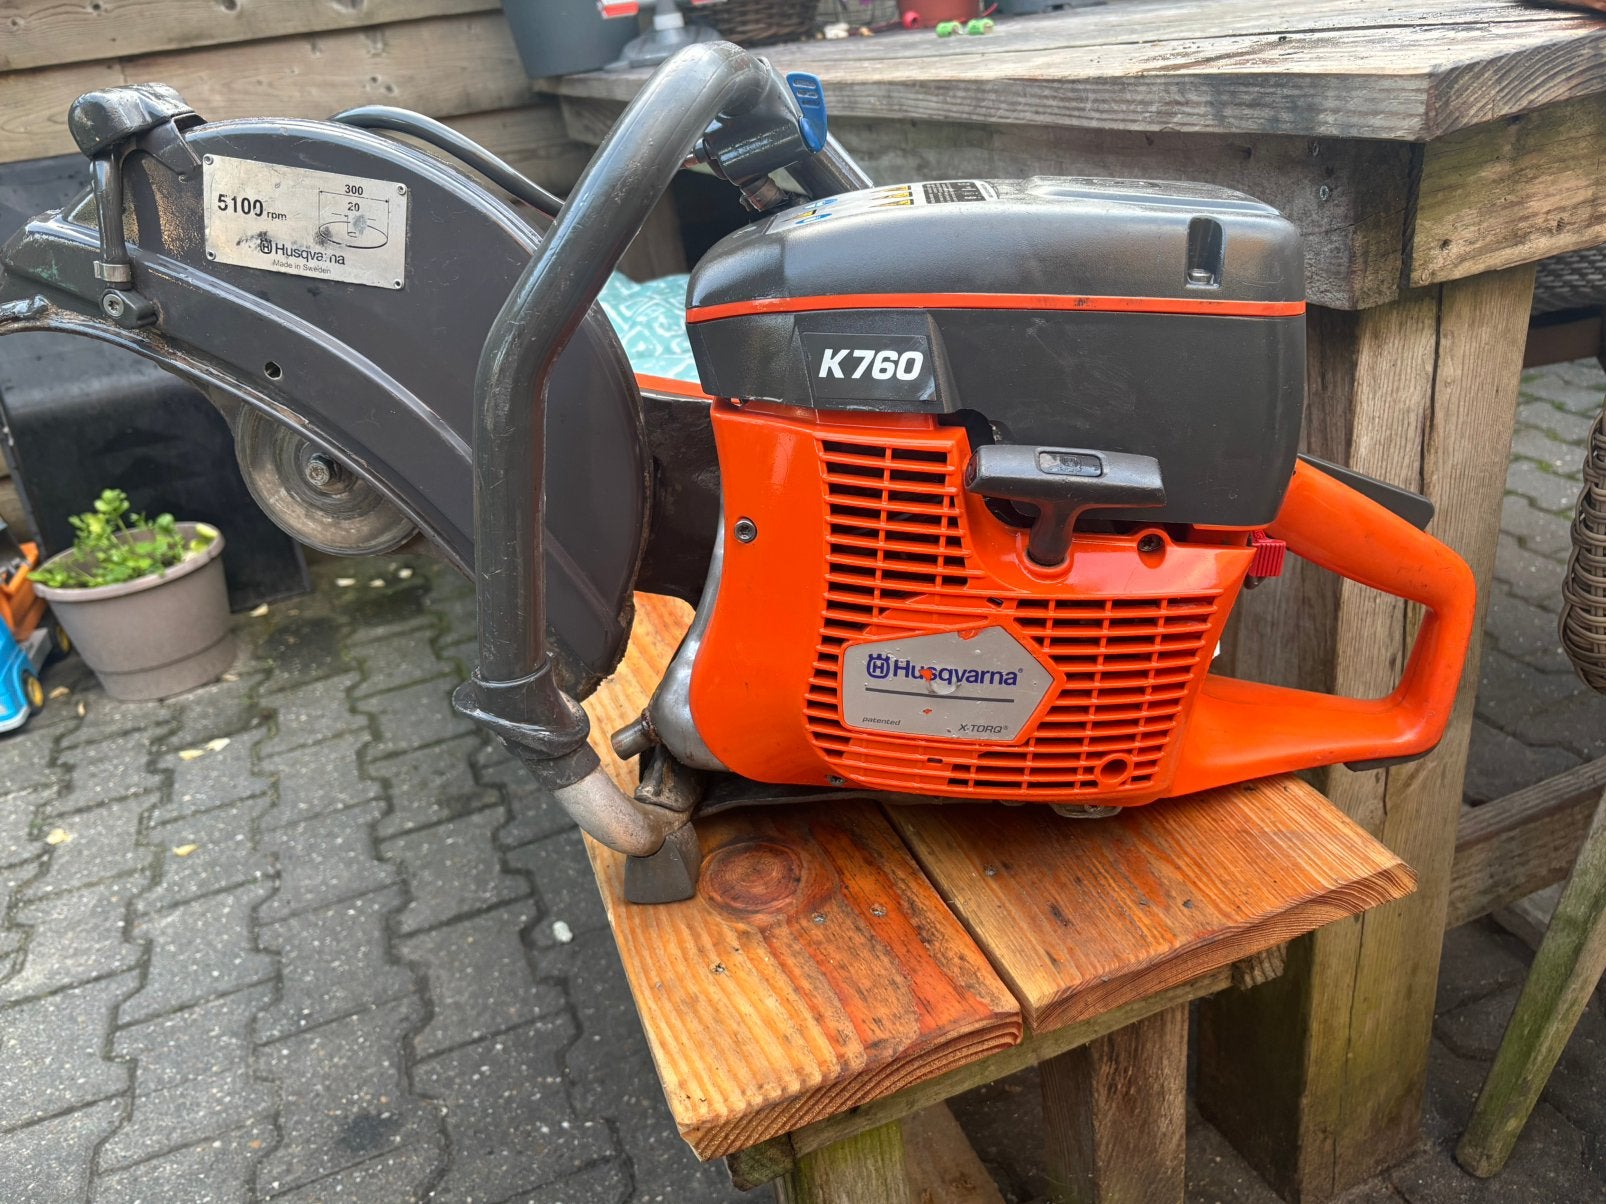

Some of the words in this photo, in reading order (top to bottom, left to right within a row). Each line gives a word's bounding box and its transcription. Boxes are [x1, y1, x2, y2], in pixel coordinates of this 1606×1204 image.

[344, 184, 364, 196] 300
[217, 193, 264, 217] 5100
[266, 210, 287, 221] rpm
[347, 202, 360, 212] 20
[272, 259, 293, 269] Made
[302, 264, 332, 274] Sweden
[818, 348, 924, 381] K760
[862, 716, 901, 726] patented
